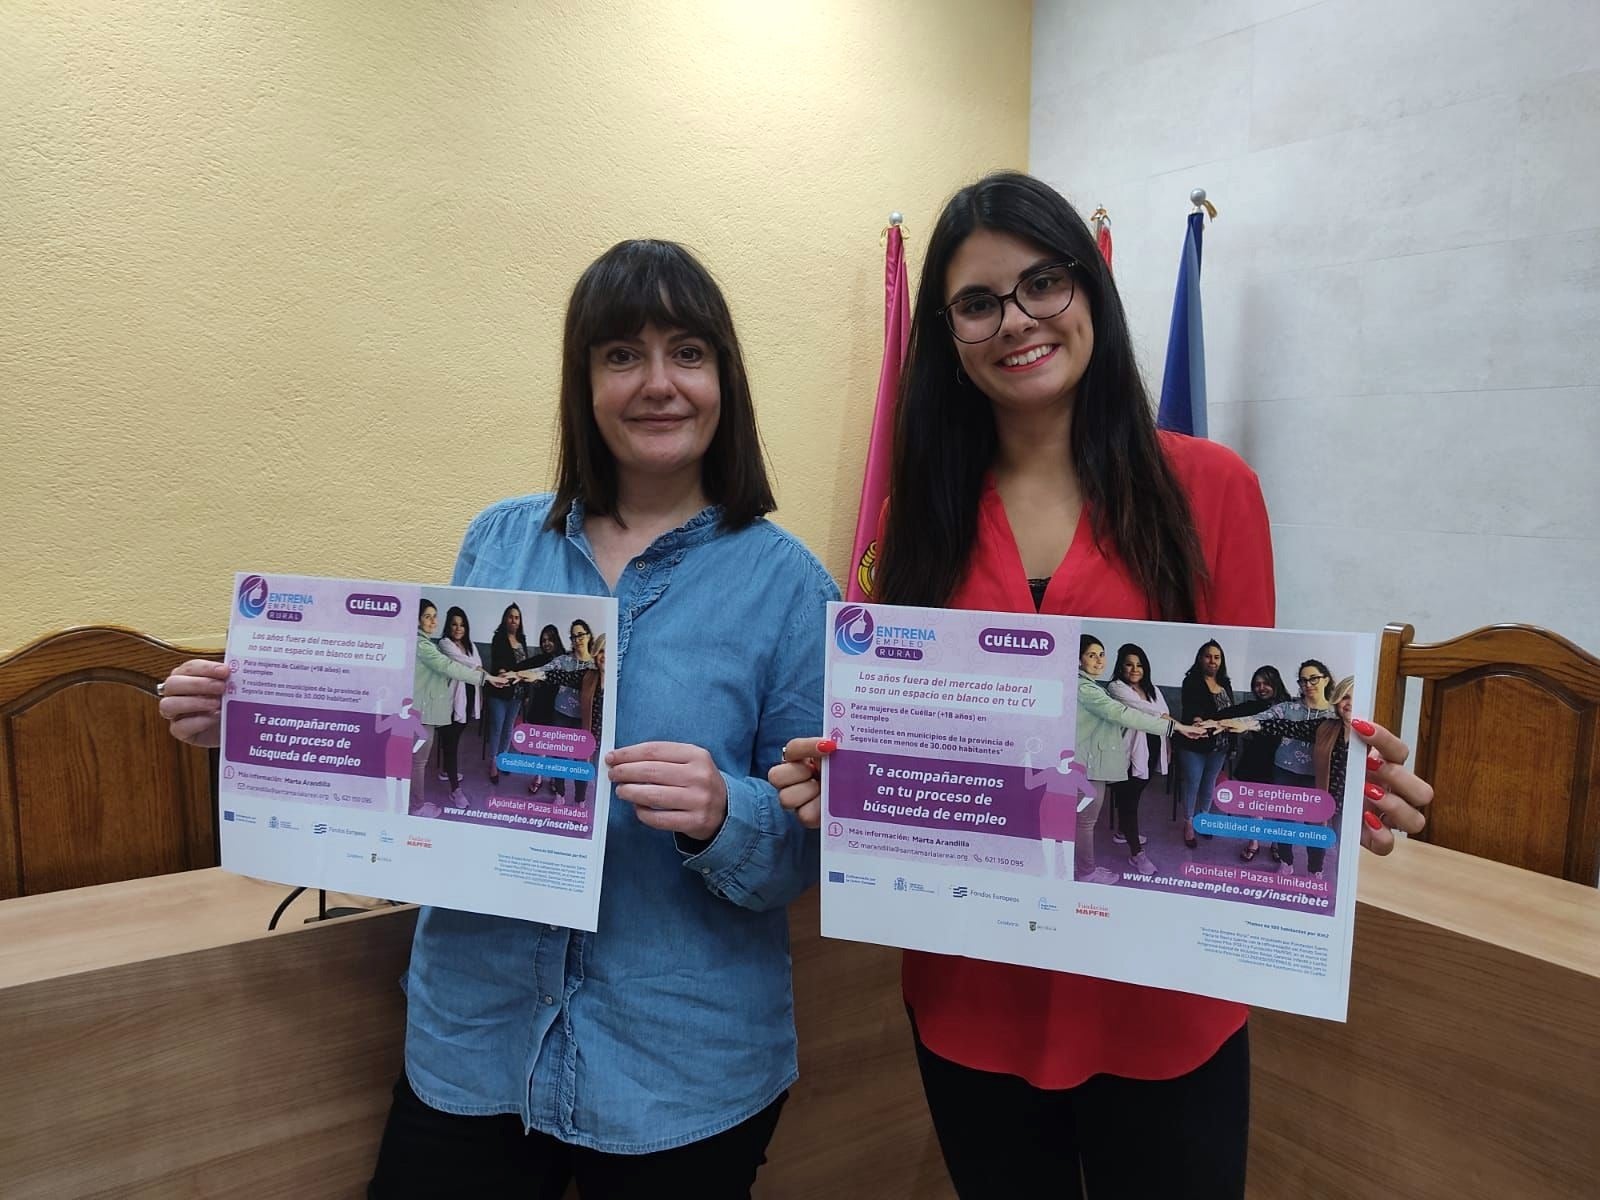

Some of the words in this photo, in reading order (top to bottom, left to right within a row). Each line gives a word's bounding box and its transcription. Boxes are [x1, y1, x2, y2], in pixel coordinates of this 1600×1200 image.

[268, 602, 304, 610] EMPLEO
[269, 593, 313, 605] ENTRENA
[350, 598, 398, 612] CUÉLLAR
[269, 612, 300, 620] RURAL
[252, 632, 266, 641] Los
[267, 633, 284, 642] años
[285, 634, 306, 644] fuera
[308, 636, 320, 645] del
[321, 637, 356, 648] mercado
[358, 640, 384, 650] laboral
[876, 626, 936, 641] ENTRENA
[984, 633, 1049, 650] CUÉLLAR
[876, 638, 923, 648] EMPLEO
[248, 644, 258, 652] no
[285, 646, 313, 658] espacio
[315, 649, 324, 657] en
[327, 650, 352, 660] blanco
[354, 652, 363, 660] en
[376, 654, 386, 662] CV
[879, 649, 919, 659] RURAL
[859, 671, 876, 682] Los
[878, 673, 900, 683] años
[902, 674, 929, 686] fuera
[932, 676, 946, 686] del
[950, 678, 993, 691] mercado
[996, 682, 1032, 694] laboral
[855, 685, 867, 694] no
[870, 686, 885, 696] son
[888, 688, 900, 696] un
[903, 688, 939, 702] espacio
[942, 692, 954, 701] en
[956, 692, 990, 705] blanco
[992, 696, 1004, 706] en
[1007, 698, 1019, 707] tu
[1021, 698, 1036, 708] CV
[851, 713, 889, 722] desempleo
[869, 706, 898, 714] mujeres
[910, 708, 936, 717] Cuéllar
[938, 711, 952, 719] (+18
[955, 713, 976, 722] años)
[254, 714, 266, 724] Te
[268, 716, 360, 733] acompañaremos
[260, 733, 274, 742] en
[276, 732, 287, 743] tu
[289, 736, 334, 748] proceso
[336, 738, 351, 748] de
[529, 728, 540, 738] De
[542, 729, 586, 743] septiembre
[850, 734, 878, 743] Segovia
[930, 742, 957, 751] 30.000
[857, 726, 894, 736] residentes
[907, 732, 946, 741] municipios
[968, 737, 1002, 746] provincia
[536, 740, 574, 753] diciembre
[250, 746, 300, 761] búsqueda
[302, 752, 317, 763] de
[319, 754, 361, 768] empleo
[502, 758, 534, 769] Posibilidad
[536, 762, 544, 770] de
[546, 763, 568, 772] realizar
[570, 766, 590, 775] online
[868, 763, 884, 777] Te
[887, 766, 1004, 788] acompañaremos
[878, 786, 894, 796] en
[898, 786, 912, 798] tu
[916, 789, 971, 804] proceso
[974, 793, 992, 806] de
[1239, 786, 1254, 796] De
[1258, 788, 1322, 804] septiembre
[488, 798, 526, 810] ¡Apúntate!
[528, 802, 550, 814] Plazas
[552, 806, 588, 818] limitadas!
[863, 800, 930, 819] búsqueda
[933, 808, 950, 820] de
[954, 810, 1006, 826] empleo
[1249, 801, 1304, 815] diciembre
[444, 806, 588, 833] www.entrenaempleo.org/inscribete
[849, 828, 863, 836] Más
[865, 830, 910, 841] información:
[912, 836, 934, 844] Marta
[936, 838, 970, 848] Arandilla
[1200, 819, 1248, 832] Posibilidad
[1250, 824, 1262, 834] de
[1264, 826, 1296, 838] realizar
[1299, 830, 1328, 841] online
[1184, 864, 1237, 880] ¡Apúntate!
[1240, 871, 1274, 884] Plazas
[1277, 875, 1328, 892] limitadas!
[1123, 872, 1328, 908] www.entrenaempleo.org/inscribete
[1076, 908, 1110, 918] MAPFRE
